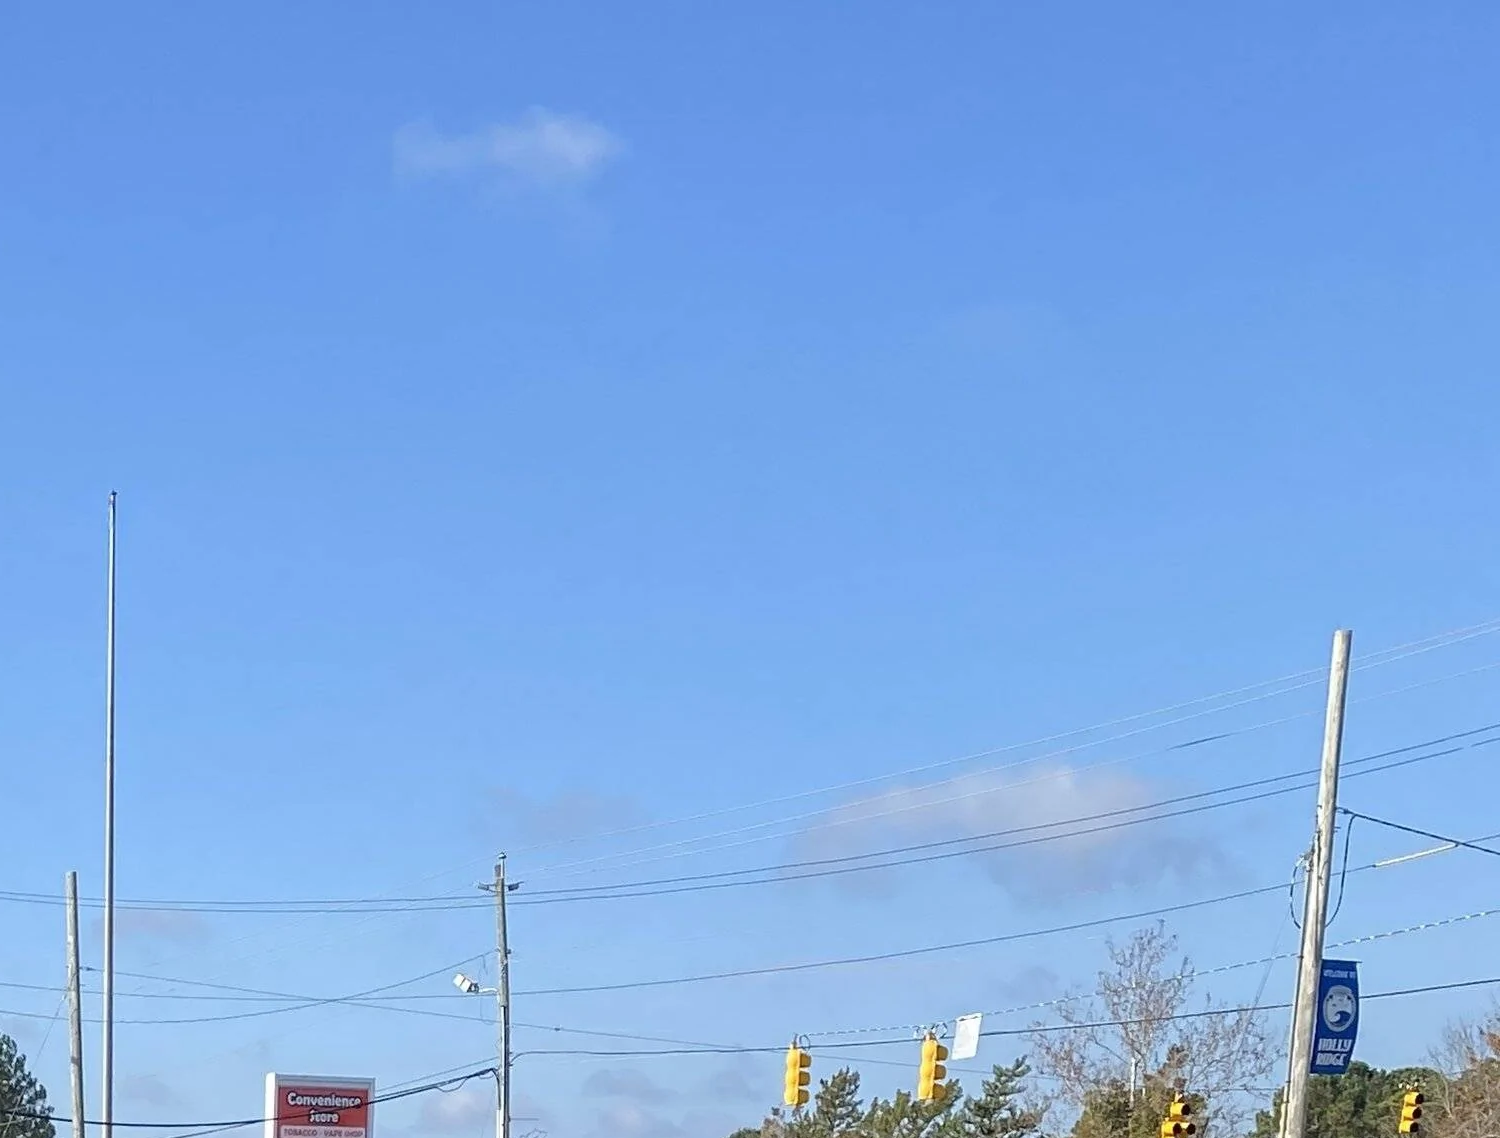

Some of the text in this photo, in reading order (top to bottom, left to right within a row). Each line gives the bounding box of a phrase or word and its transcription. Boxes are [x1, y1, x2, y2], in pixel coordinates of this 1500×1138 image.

[1318, 1038, 1352, 1052] HOLLY
[1316, 1052, 1348, 1067] RIDGE
[287, 1092, 361, 1107] Convenience
[309, 1110, 339, 1122] Store
